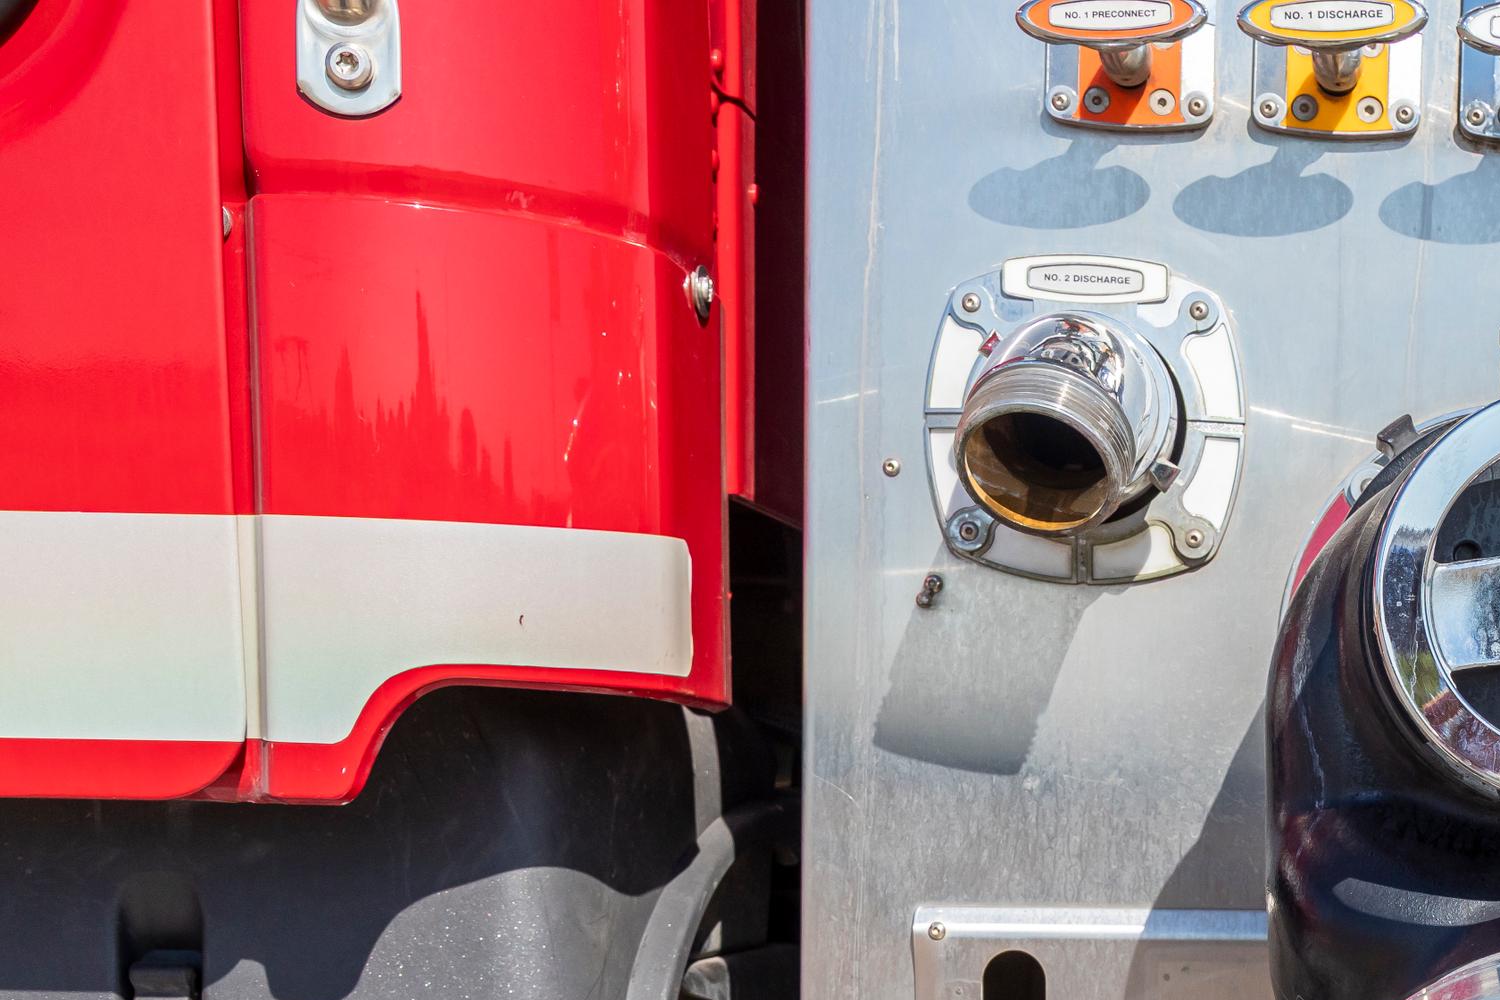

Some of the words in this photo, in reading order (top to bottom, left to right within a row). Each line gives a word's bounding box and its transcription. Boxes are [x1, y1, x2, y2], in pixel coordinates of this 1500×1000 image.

[1064, 10, 1081, 19] NO.
[1092, 8, 1156, 18] PRECONNECT
[1284, 11, 1303, 20] NO.
[1317, 9, 1384, 19] DISCHARGE
[1044, 273, 1062, 282] NO.
[1064, 274, 1070, 282] 2
[1073, 274, 1131, 285] DISCHARGE
